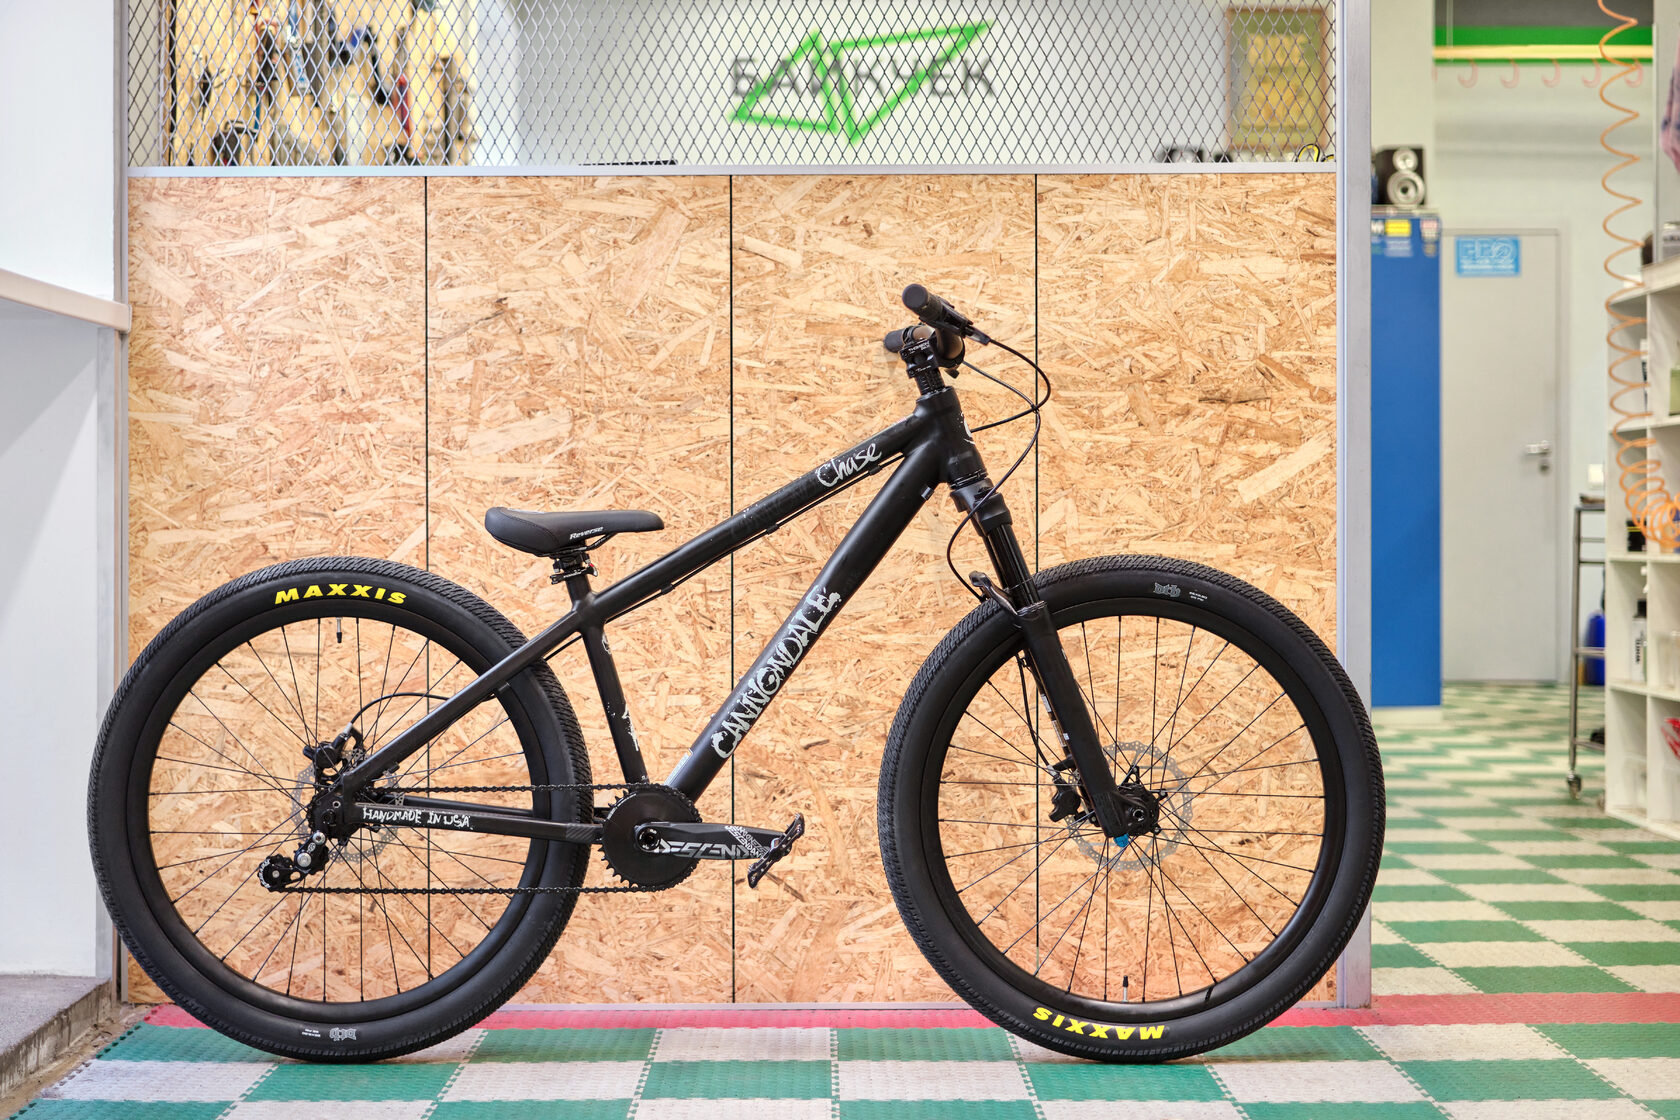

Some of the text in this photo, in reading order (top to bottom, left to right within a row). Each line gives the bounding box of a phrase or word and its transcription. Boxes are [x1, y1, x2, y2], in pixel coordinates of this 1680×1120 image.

[815, 443, 882, 487] Chase
[569, 526, 604, 540] Reverse
[274, 583, 407, 604] MAXXIS
[710, 584, 842, 759] CANNONDALE
[363, 806, 421, 823] HANDMADE
[427, 811, 441, 824] IN
[1032, 1006, 1165, 1040] MAXXIS
